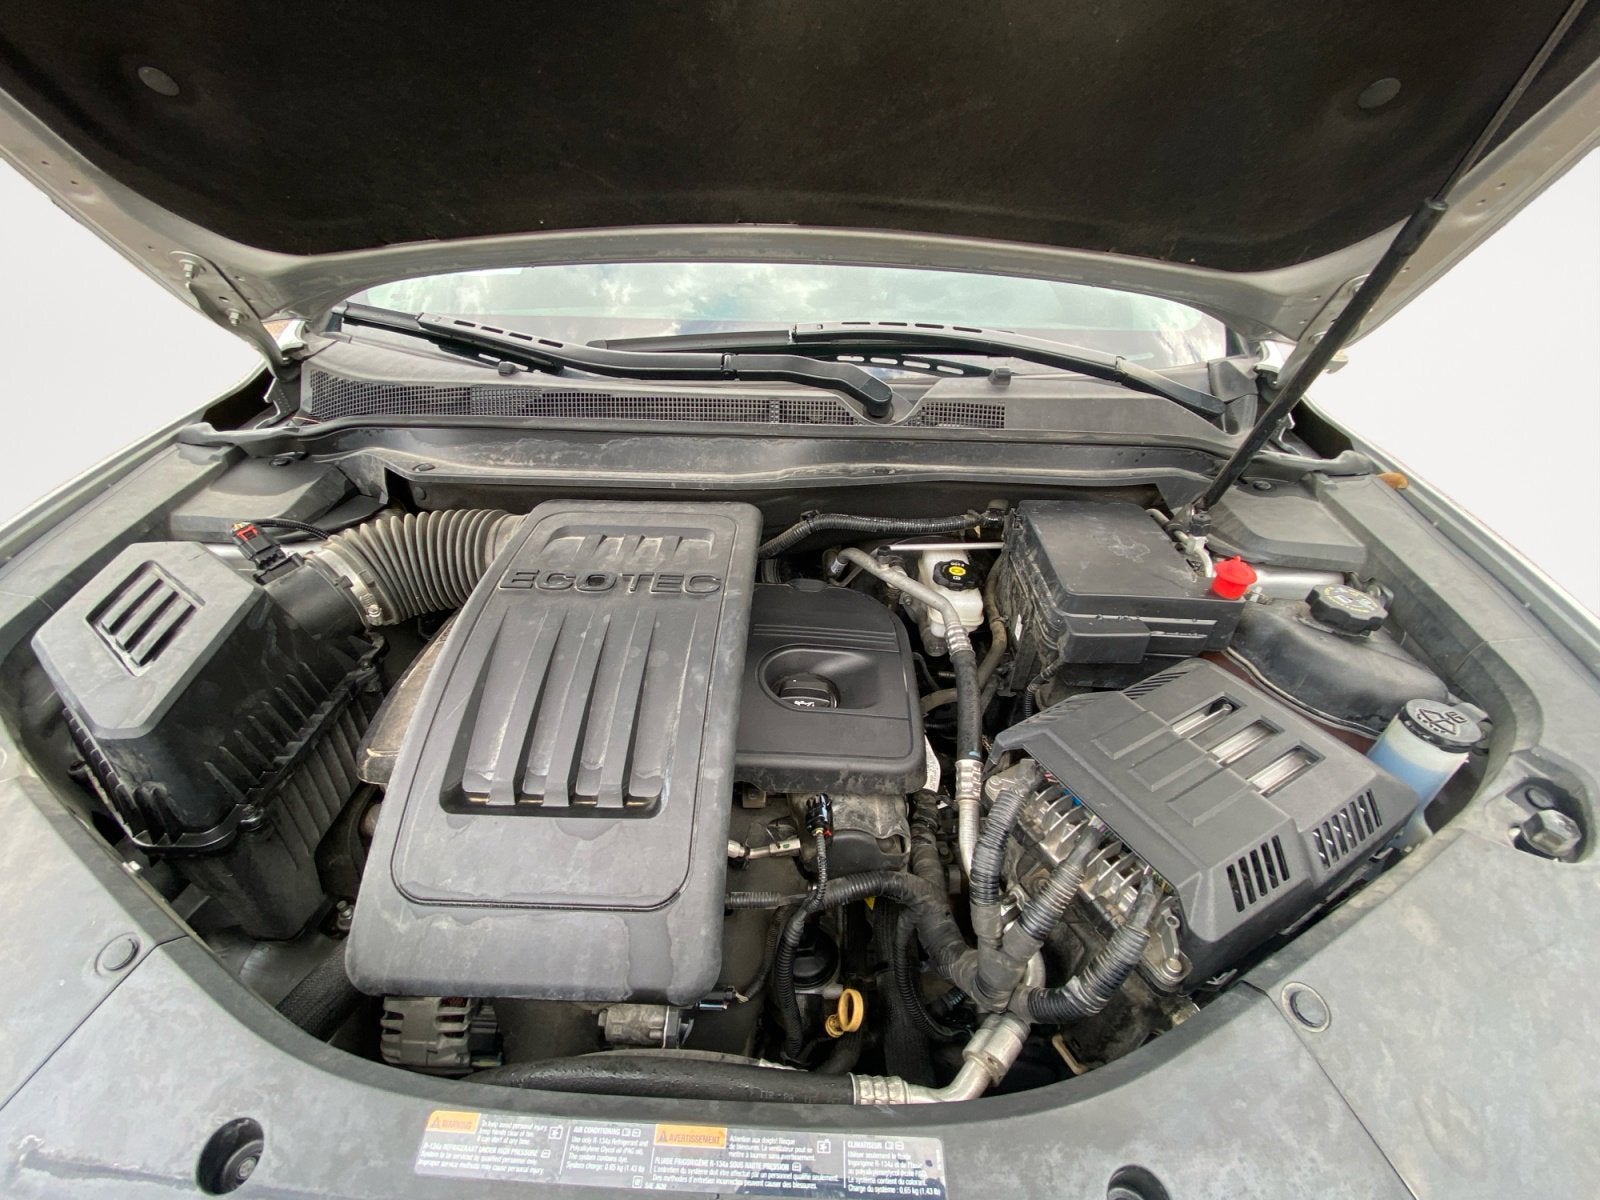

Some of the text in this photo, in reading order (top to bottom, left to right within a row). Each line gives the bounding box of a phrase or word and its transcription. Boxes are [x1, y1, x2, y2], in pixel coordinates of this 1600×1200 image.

[499, 569, 722, 594] ECOTEC
[584, 1127, 620, 1135] CONDITIONING
[669, 1134, 720, 1144] AVERTISSEMENT
[848, 1184, 866, 1193] Charge
